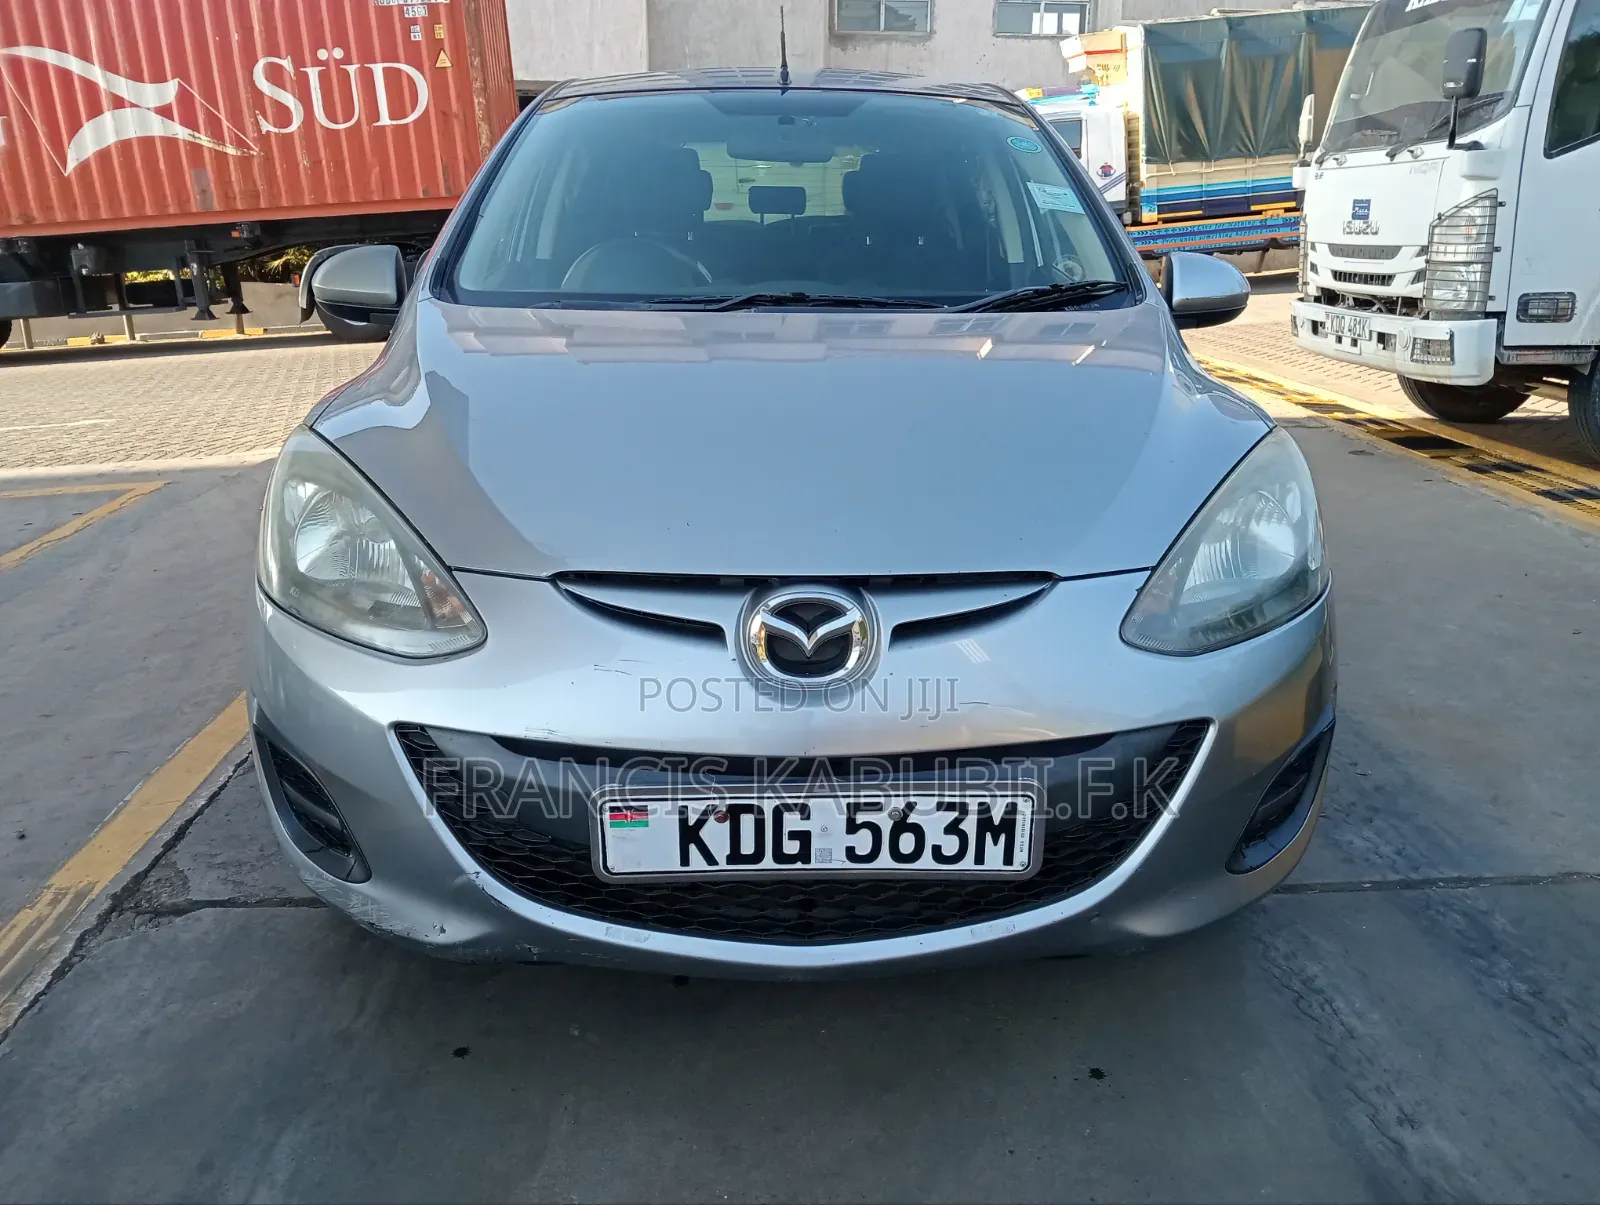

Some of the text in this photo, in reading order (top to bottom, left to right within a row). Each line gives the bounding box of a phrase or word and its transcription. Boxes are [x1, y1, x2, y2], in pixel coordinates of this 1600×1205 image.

[253, 47, 429, 134] SÜD
[1342, 220, 1380, 235] ISUZU
[678, 802, 813, 867] KDG
[844, 801, 1018, 867] 563M
